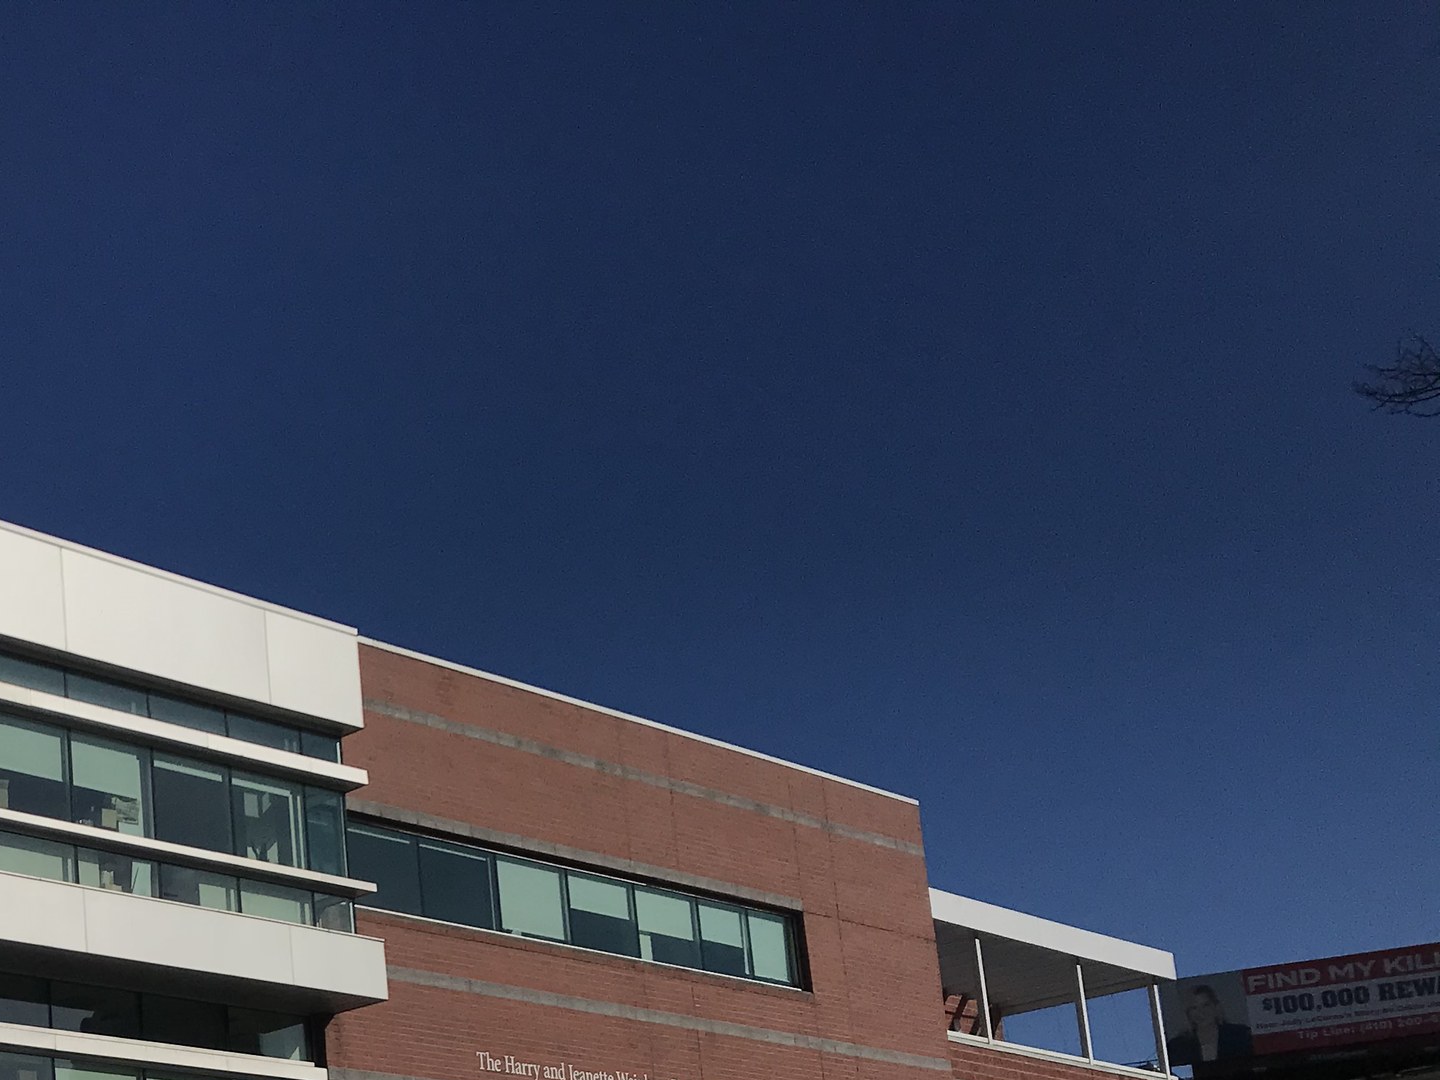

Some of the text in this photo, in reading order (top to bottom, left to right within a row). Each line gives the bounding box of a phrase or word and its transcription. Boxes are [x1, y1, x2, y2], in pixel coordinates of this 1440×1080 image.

[1247, 968, 1321, 993] FIND
[1327, 959, 1376, 982] MY
[1378, 976, 1440, 1001] REW
[476, 1051, 502, 1072] The
[543, 1062, 566, 1080] and
